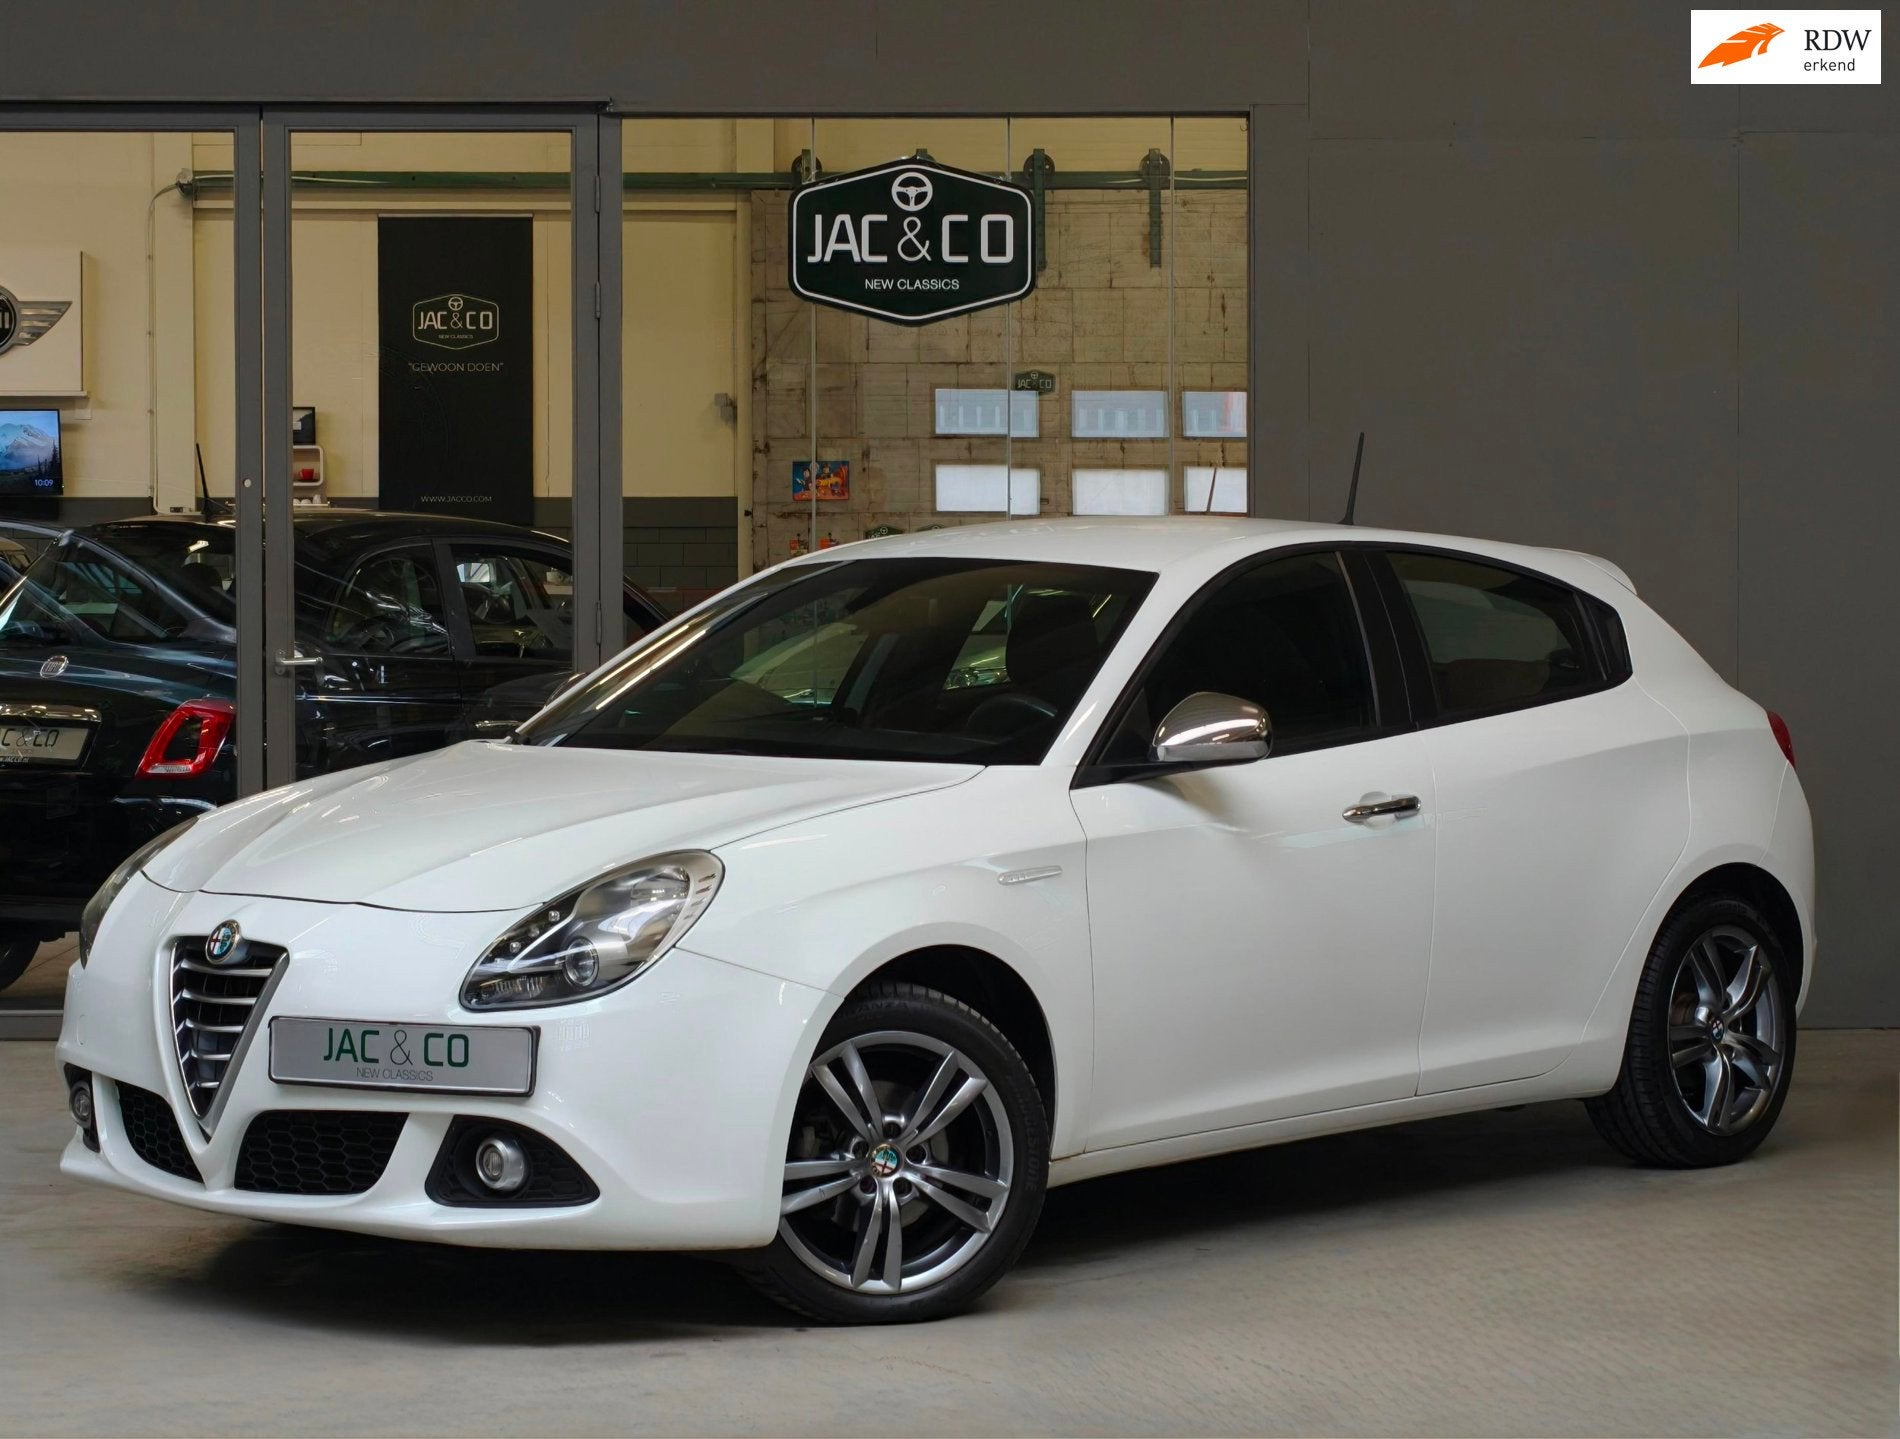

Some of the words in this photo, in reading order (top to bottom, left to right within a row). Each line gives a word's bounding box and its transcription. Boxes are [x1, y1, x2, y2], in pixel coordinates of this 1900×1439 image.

[807, 214, 888, 263] JAC
[897, 216, 932, 262] &
[941, 214, 1014, 263] CO
[865, 279, 894, 290] NEW
[897, 278, 960, 290] CLASSICS
[418, 311, 448, 330] JAC
[450, 312, 463, 329] &
[465, 311, 493, 330] CO
[1017, 379, 1032, 389] JAC
[34, 479, 54, 487] 10:09
[323, 1027, 380, 1064] JAC
[390, 1029, 413, 1066] &
[423, 1032, 470, 1068] CO
[356, 1067, 380, 1079] NEW
[382, 1069, 434, 1082] CLASSICS
